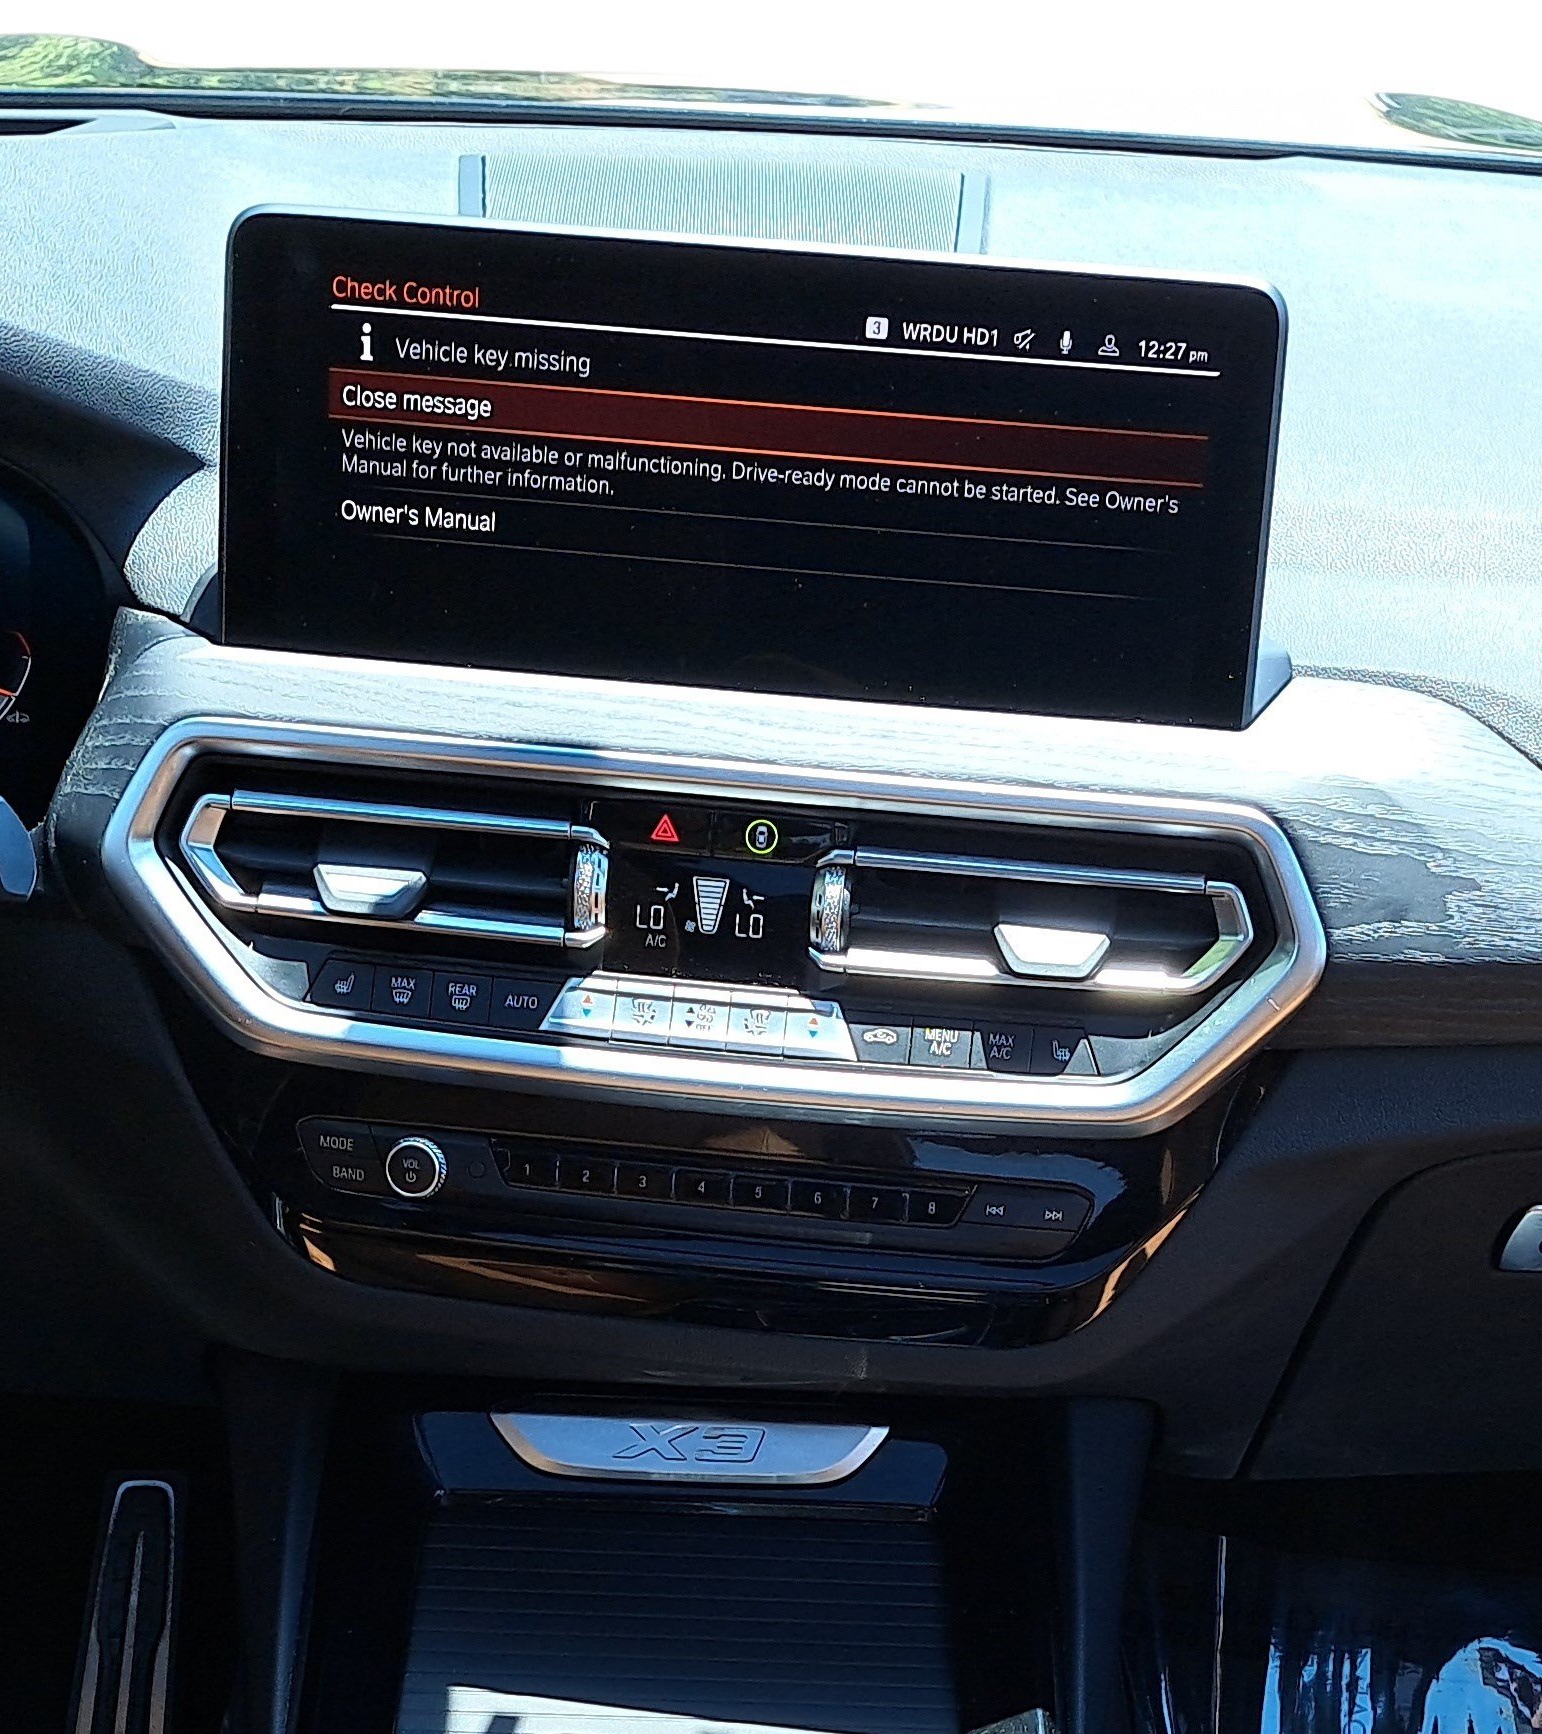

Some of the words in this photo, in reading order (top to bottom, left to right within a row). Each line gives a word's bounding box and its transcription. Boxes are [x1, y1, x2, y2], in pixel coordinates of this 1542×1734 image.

[332, 276, 397, 301] Check
[403, 282, 479, 308] Control
[902, 321, 958, 344] WRDU
[963, 326, 998, 347] HD1
[396, 337, 467, 363] Vehicle
[474, 344, 508, 371] key
[514, 348, 591, 378] missing
[1137, 340, 1187, 361] 12:27
[1189, 350, 1208, 363] pm
[342, 385, 397, 409] Close
[403, 393, 492, 421] message
[341, 428, 407, 452] Vehicle
[412, 433, 442, 459] key
[447, 441, 476, 458] not
[481, 442, 558, 465] available
[564, 452, 583, 467] or
[587, 450, 726, 482] malfunctioning.
[732, 461, 835, 492] Drive-ready
[840, 472, 890, 493] mode
[896, 478, 959, 498] cannot
[964, 480, 986, 500] be
[991, 485, 1061, 505] started.
[1065, 488, 1100, 507] See
[1105, 491, 1179, 514] Owner's
[341, 453, 407, 477] Manual
[412, 460, 437, 480] for
[442, 462, 503, 486] further
[507, 468, 614, 495] information.
[341, 500, 419, 526] Owner's
[425, 506, 496, 532] Manual
[636, 904, 664, 930] LO
[735, 913, 764, 939] LO
[645, 934, 667, 948] A/C
[390, 976, 416, 990] MAX
[448, 982, 477, 996] REAR
[505, 994, 538, 1009] AUTO
[924, 1027, 958, 1043] MENU
[989, 1032, 1014, 1047] MAX
[929, 1041, 952, 1056] A/C
[989, 1047, 1012, 1060] A/C
[319, 1135, 354, 1151] MODE
[402, 1158, 420, 1169] VOL
[524, 1163, 530, 1176] 1
[332, 1165, 365, 1181] BAND
[582, 1170, 590, 1183] 2
[639, 1175, 647, 1188] 3
[697, 1180, 706, 1193] 4
[754, 1186, 762, 1199] 5
[814, 1191, 822, 1204] 6
[871, 1196, 879, 1209] 7
[928, 1201, 936, 1214] 8
[612, 1423, 765, 1463] X3
